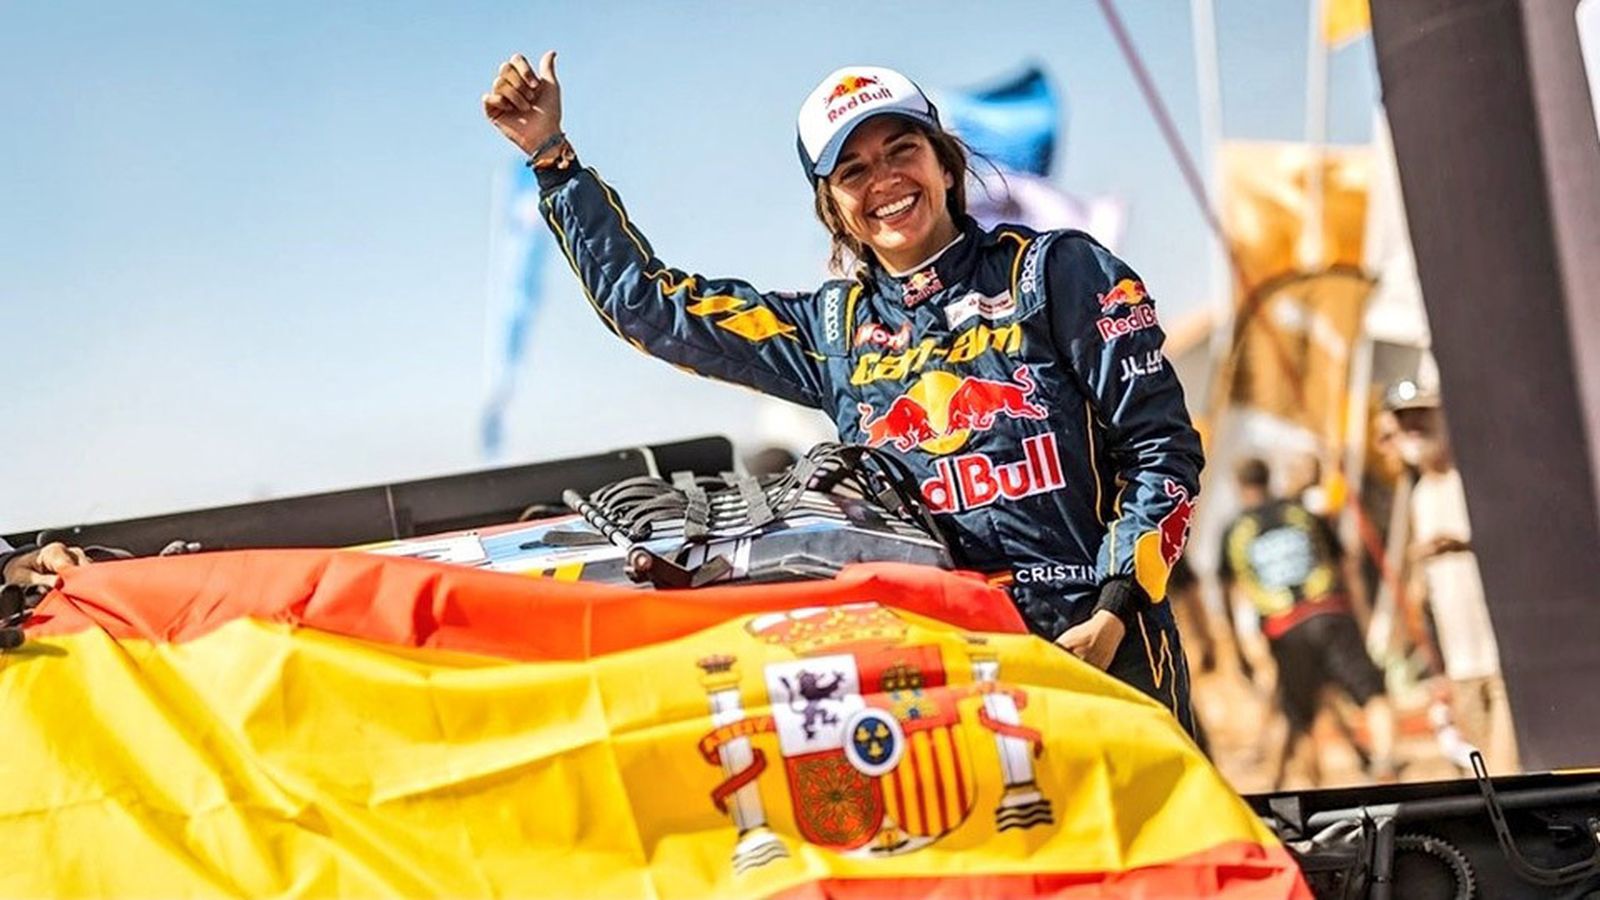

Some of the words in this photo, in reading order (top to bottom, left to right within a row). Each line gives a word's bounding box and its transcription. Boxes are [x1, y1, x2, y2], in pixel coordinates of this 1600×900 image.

[827, 96, 858, 123] Red
[859, 87, 893, 103] Bull
[1097, 305, 1142, 342] Red
[1139, 303, 1158, 328] B
[954, 432, 1066, 510] Bull
[1015, 564, 1099, 585] CRISTIN
